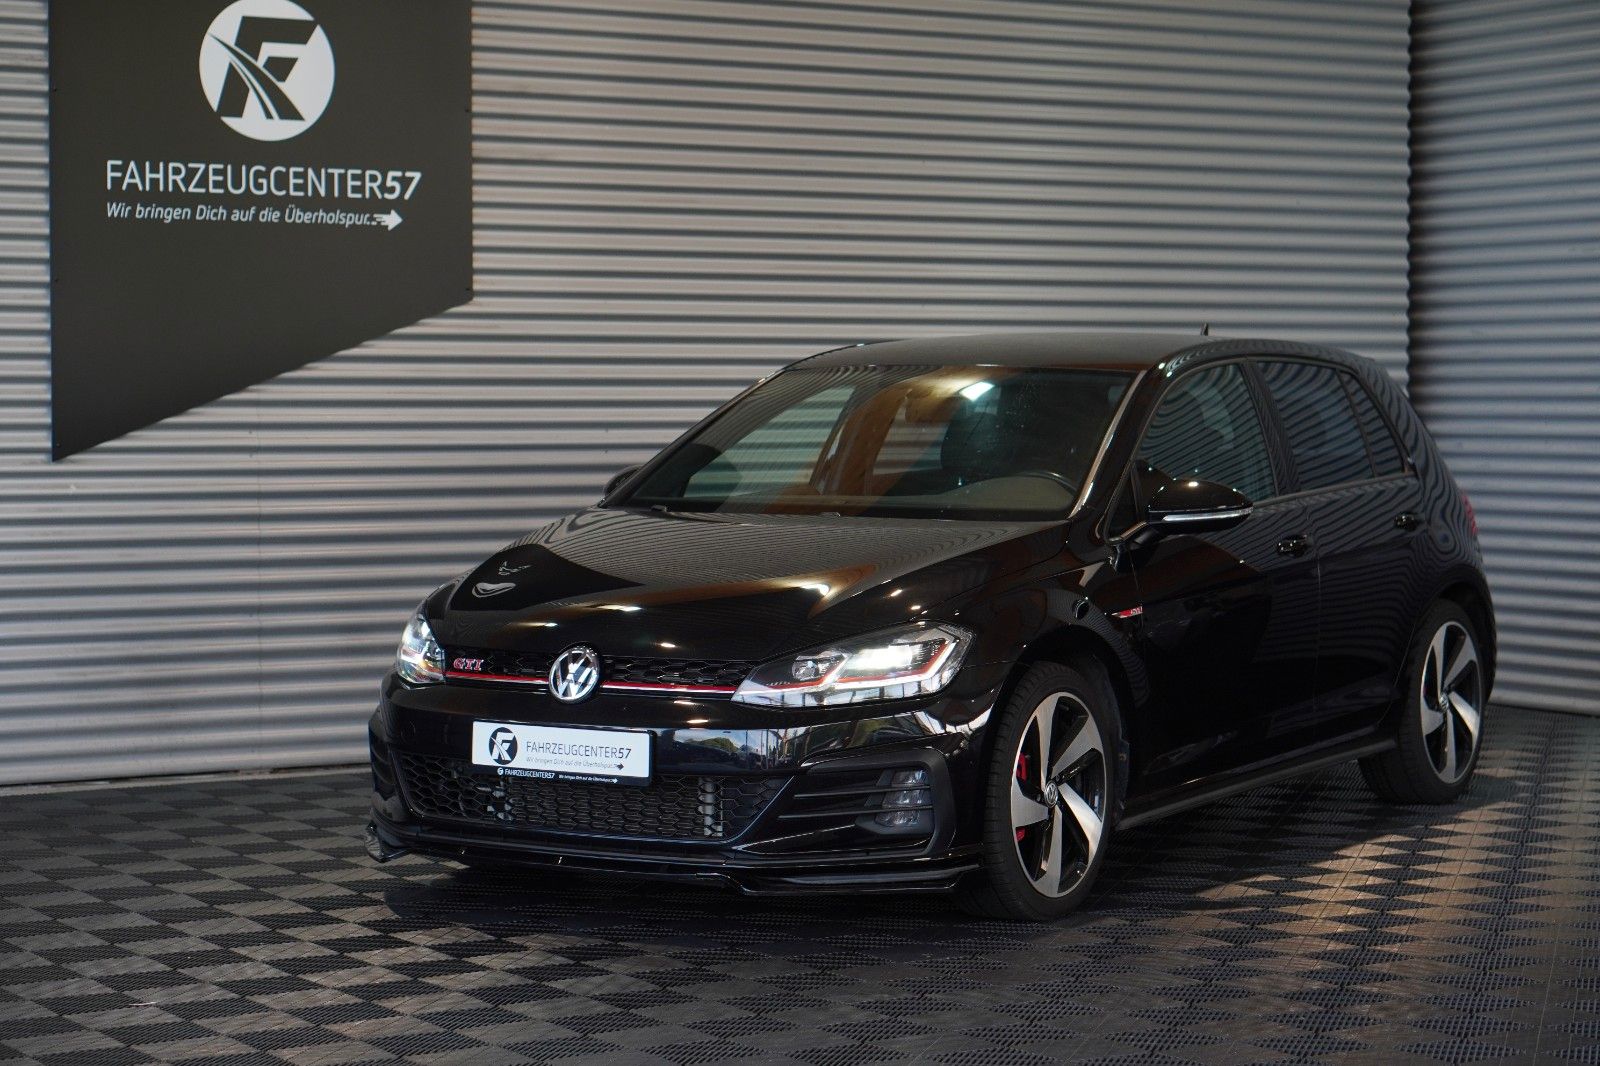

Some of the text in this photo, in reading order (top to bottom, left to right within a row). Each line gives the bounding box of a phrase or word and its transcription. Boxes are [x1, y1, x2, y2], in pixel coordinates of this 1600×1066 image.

[106, 159, 422, 200] FAHRZEUGCENTER57
[106, 202, 131, 218] Wir
[135, 203, 191, 223] bringen
[195, 205, 227, 220] Dich
[231, 206, 256, 222] auf
[259, 207, 280, 223] die
[453, 657, 484, 671] GTI
[526, 741, 632, 759] FAHRZEUGCENTER57
